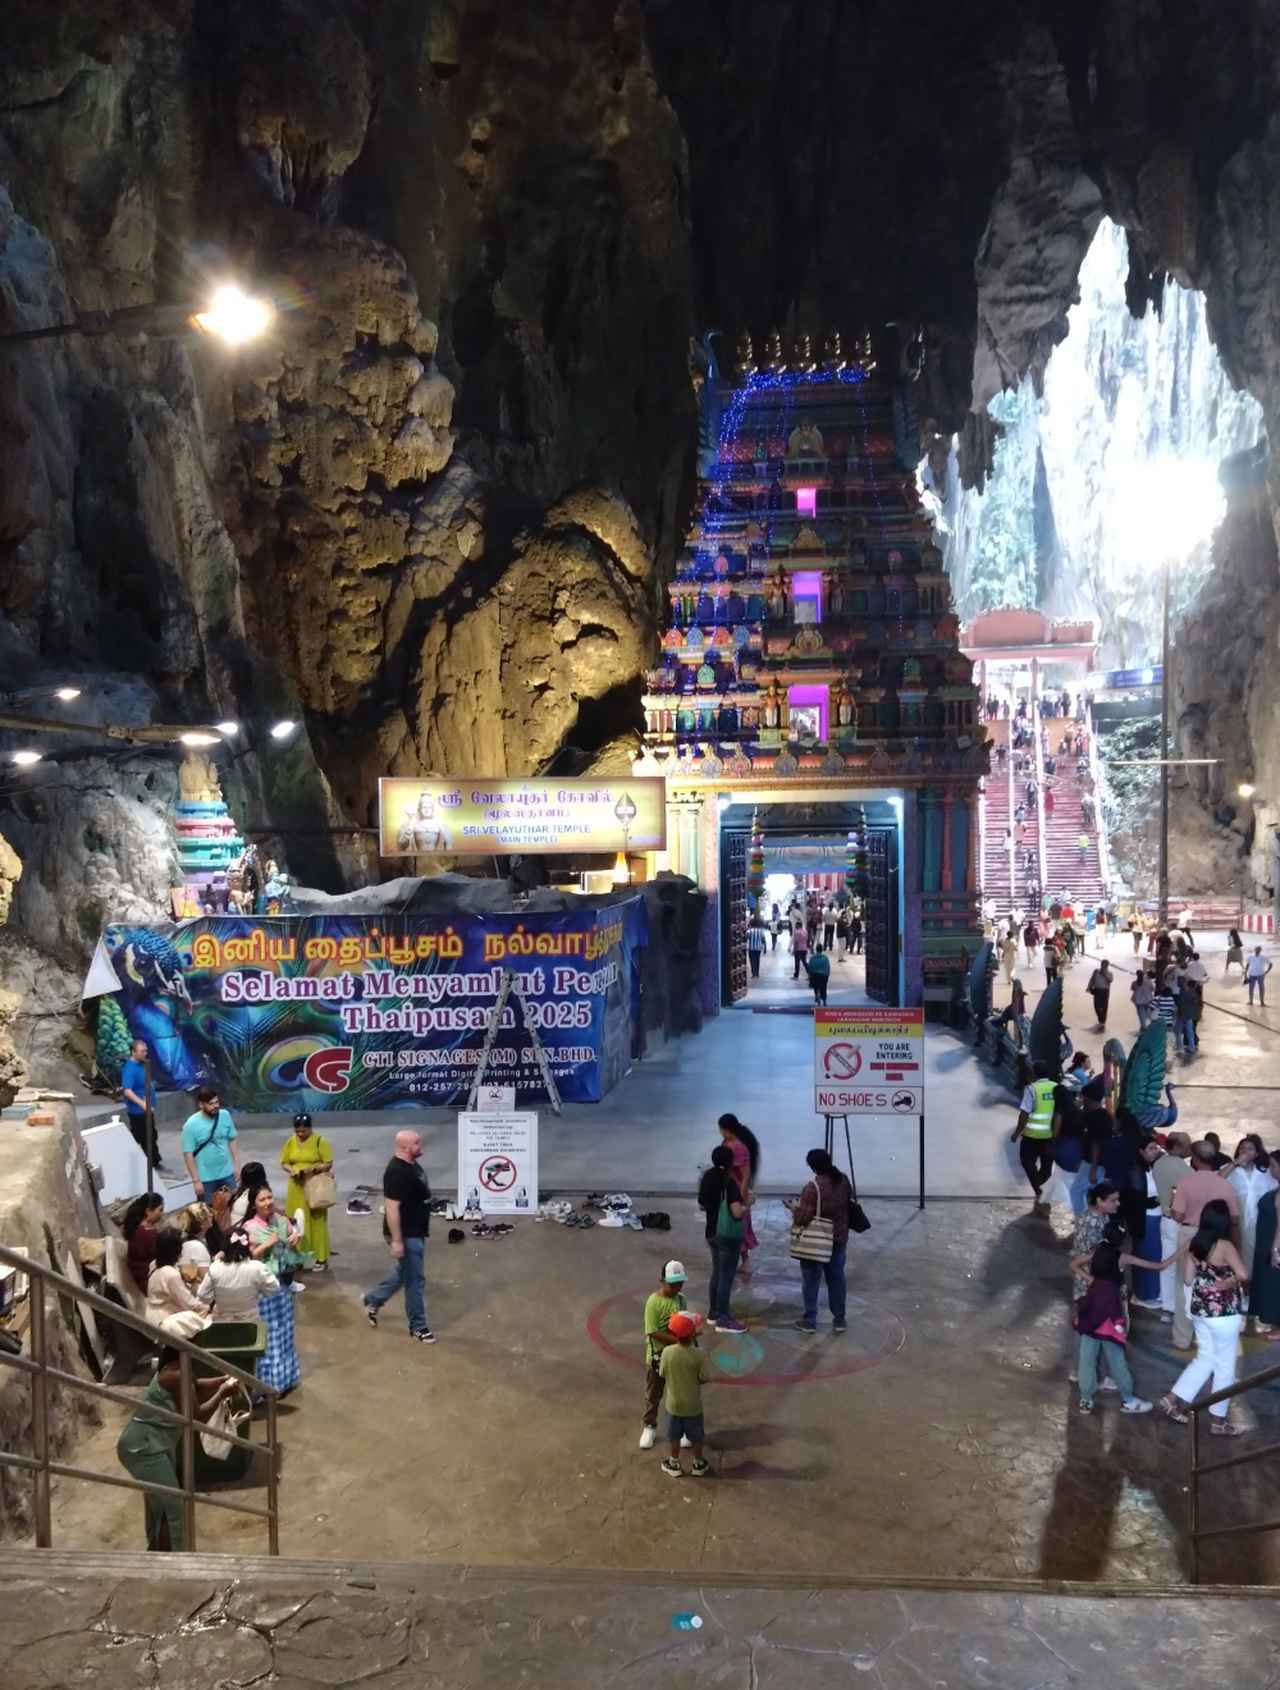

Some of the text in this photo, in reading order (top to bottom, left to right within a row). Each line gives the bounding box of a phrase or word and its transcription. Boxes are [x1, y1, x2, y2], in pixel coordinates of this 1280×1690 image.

[463, 824, 591, 835] SRI VELAYUTHAR TEMPLE
[192, 928, 296, 968] இனிய
[305, 925, 463, 966] தைப்பூசம்
[222, 969, 355, 1001] Selamat
[525, 1000, 592, 1029] 2025
[879, 1043, 910, 1051] YOU ARE
[362, 1051, 395, 1068] CTI
[488, 1048, 517, 1067] (M)
[876, 1052, 913, 1060] ENTERING
[819, 1093, 888, 1107] NO SHOES
